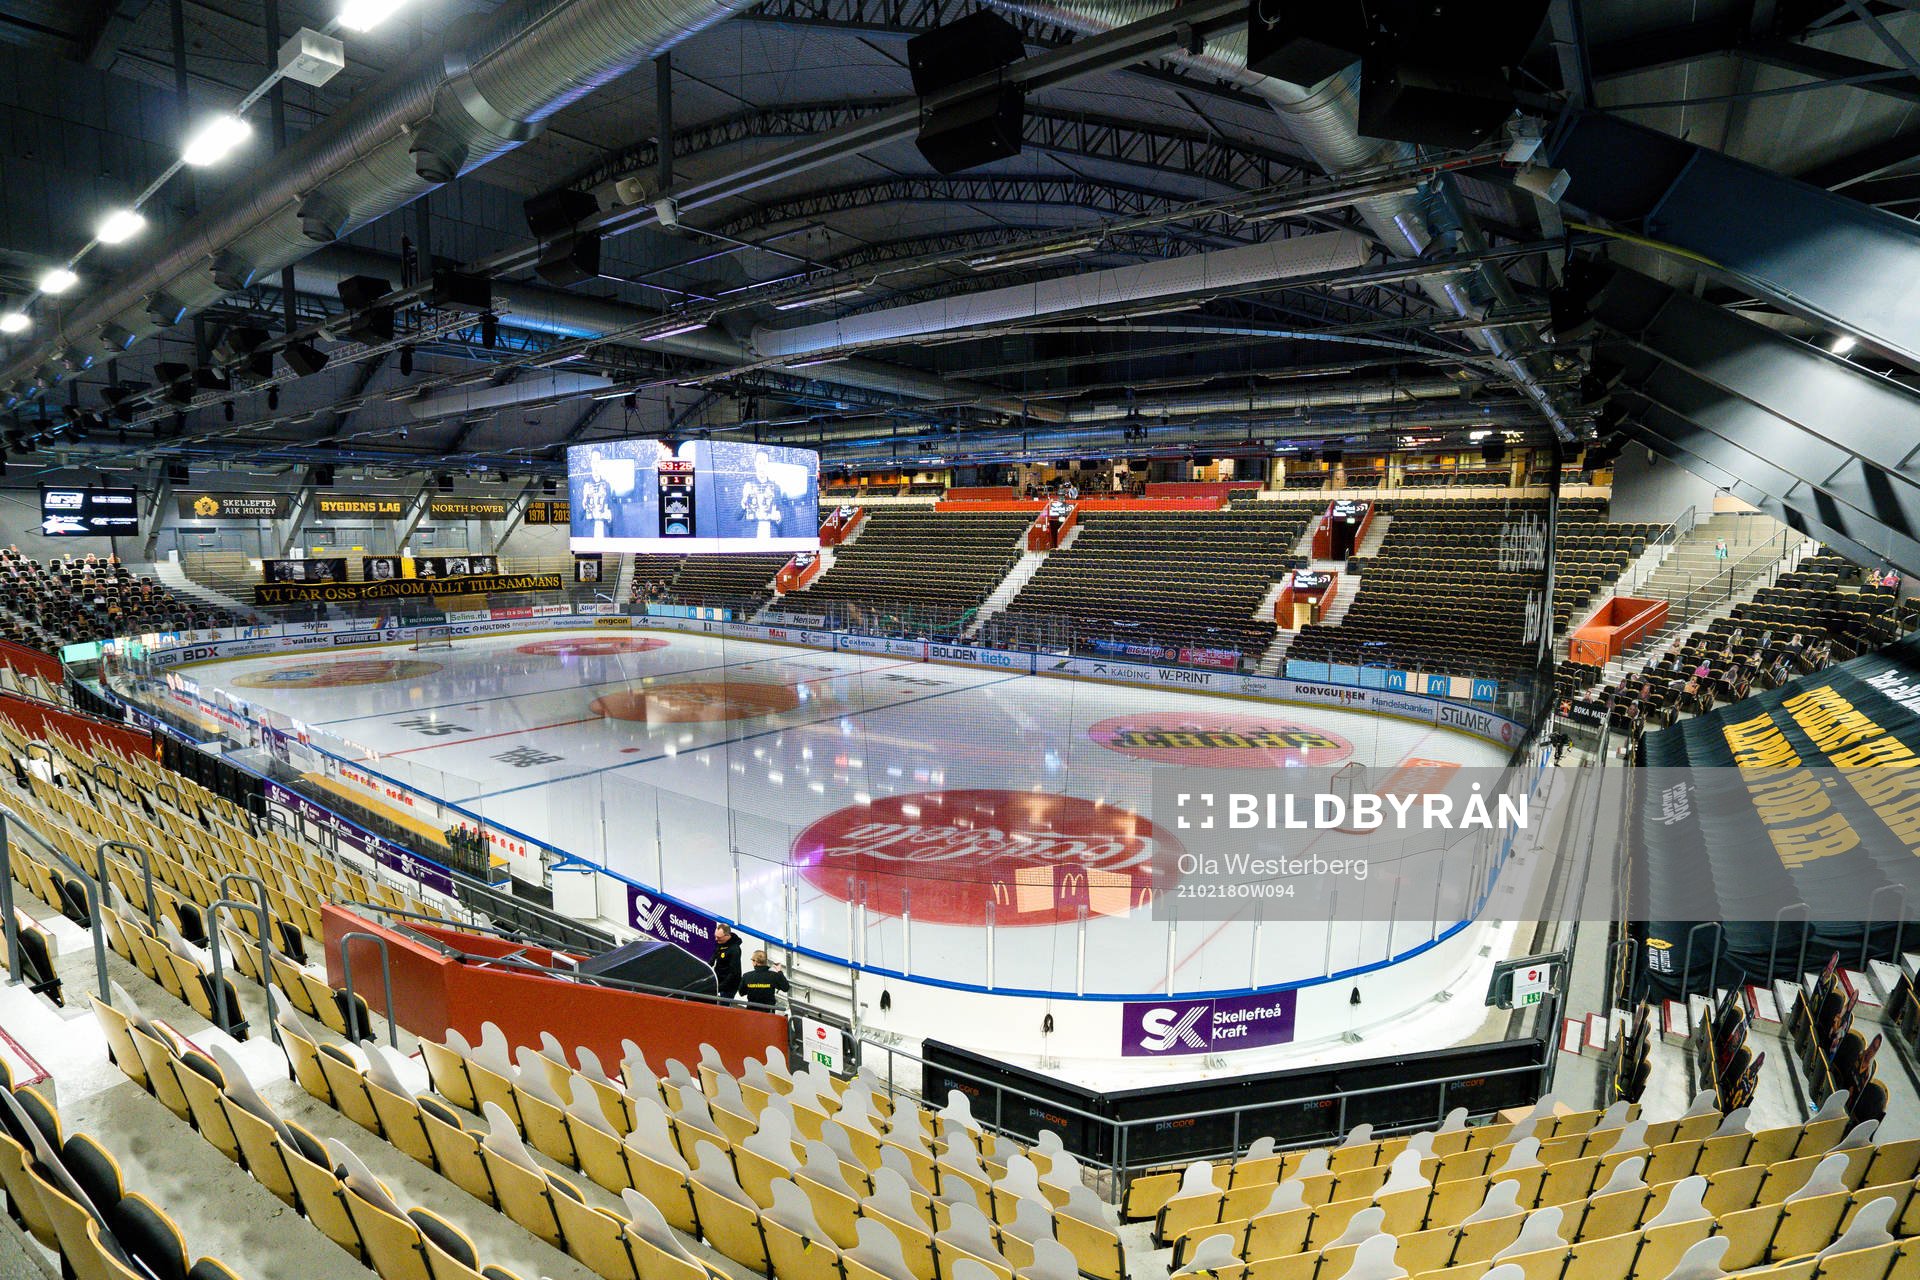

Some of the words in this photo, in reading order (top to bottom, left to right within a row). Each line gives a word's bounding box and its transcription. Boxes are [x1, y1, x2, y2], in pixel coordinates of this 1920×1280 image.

[222, 498, 277, 508] SKELLEFTEÅ
[320, 501, 376, 512] BYGDENS
[378, 501, 401, 512] LAG
[431, 504, 468, 513] NORTH
[470, 504, 505, 513] POWER
[225, 507, 241, 515] AIK
[242, 507, 276, 515] HOCKEY
[528, 509, 546, 521] 1978
[553, 510, 570, 521] 2013
[260, 589, 281, 602] VI
[285, 587, 321, 600] TAR
[324, 587, 358, 600] OSS
[361, 581, 426, 598] IGENOM
[429, 580, 465, 594] ALLT
[468, 576, 560, 592] TILLSAMMANS
[598, 617, 628, 626] engcon
[292, 636, 329, 645] valutec
[183, 647, 220, 662] BDX
[932, 646, 977, 662] BOLIDEN
[981, 651, 1011, 667] tieto
[1110, 668, 1151, 680] KAIDING
[1371, 696, 1433, 715] Handelsbanken
[1573, 705, 1590, 716] BOKA
[1747, 769, 1838, 825] FÖR
[669, 913, 709, 940] Skellefteå
[669, 926, 691, 944] Kraft
[1212, 1003, 1282, 1025] Skellefteå
[1212, 1024, 1248, 1040] Kraft
[943, 1078, 980, 1097] pixcore
[1450, 1077, 1486, 1091] pixcore
[1028, 1106, 1068, 1128] pixcore
[1154, 1117, 1196, 1132] pixcore
